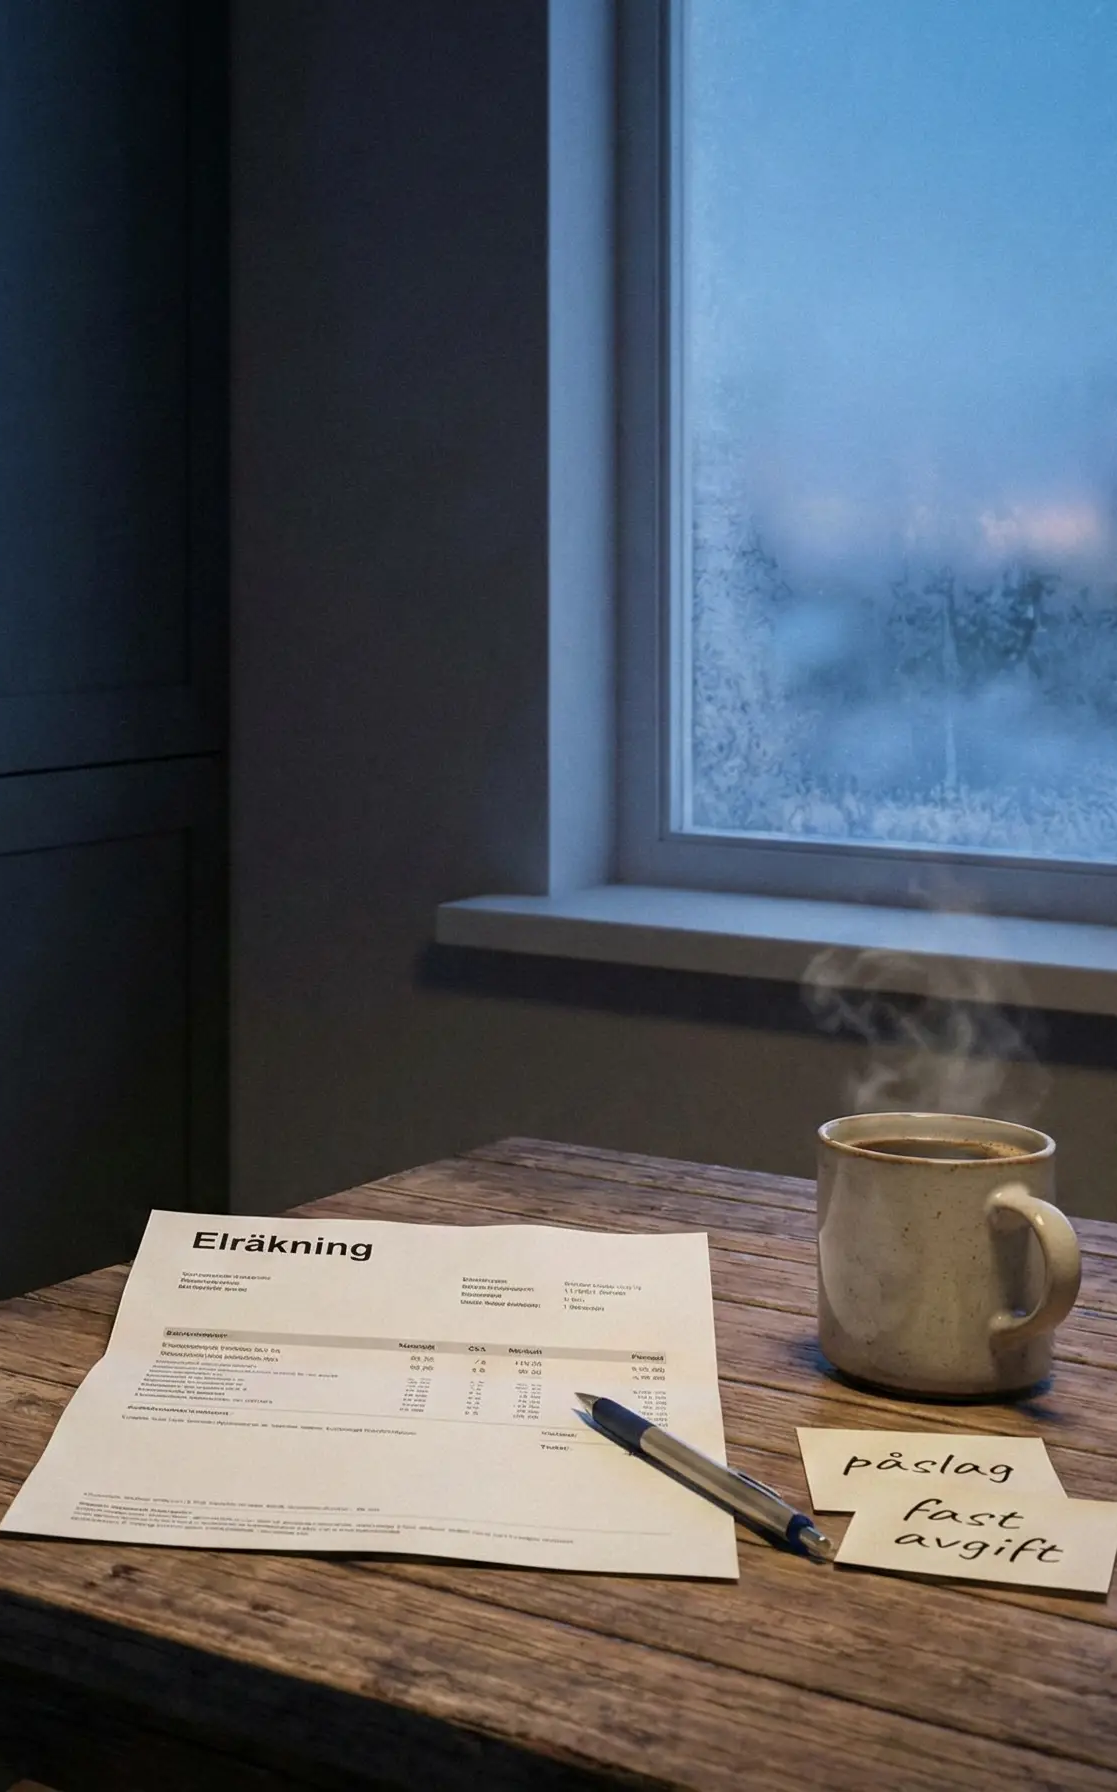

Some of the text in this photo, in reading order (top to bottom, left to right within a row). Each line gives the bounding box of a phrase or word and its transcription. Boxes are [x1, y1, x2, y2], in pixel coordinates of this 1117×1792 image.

[192, 1231, 373, 1262] Elräkning
[843, 1452, 1014, 1483] påslag
[903, 1498, 1024, 1530] fast
[894, 1533, 1064, 1563] avgift
